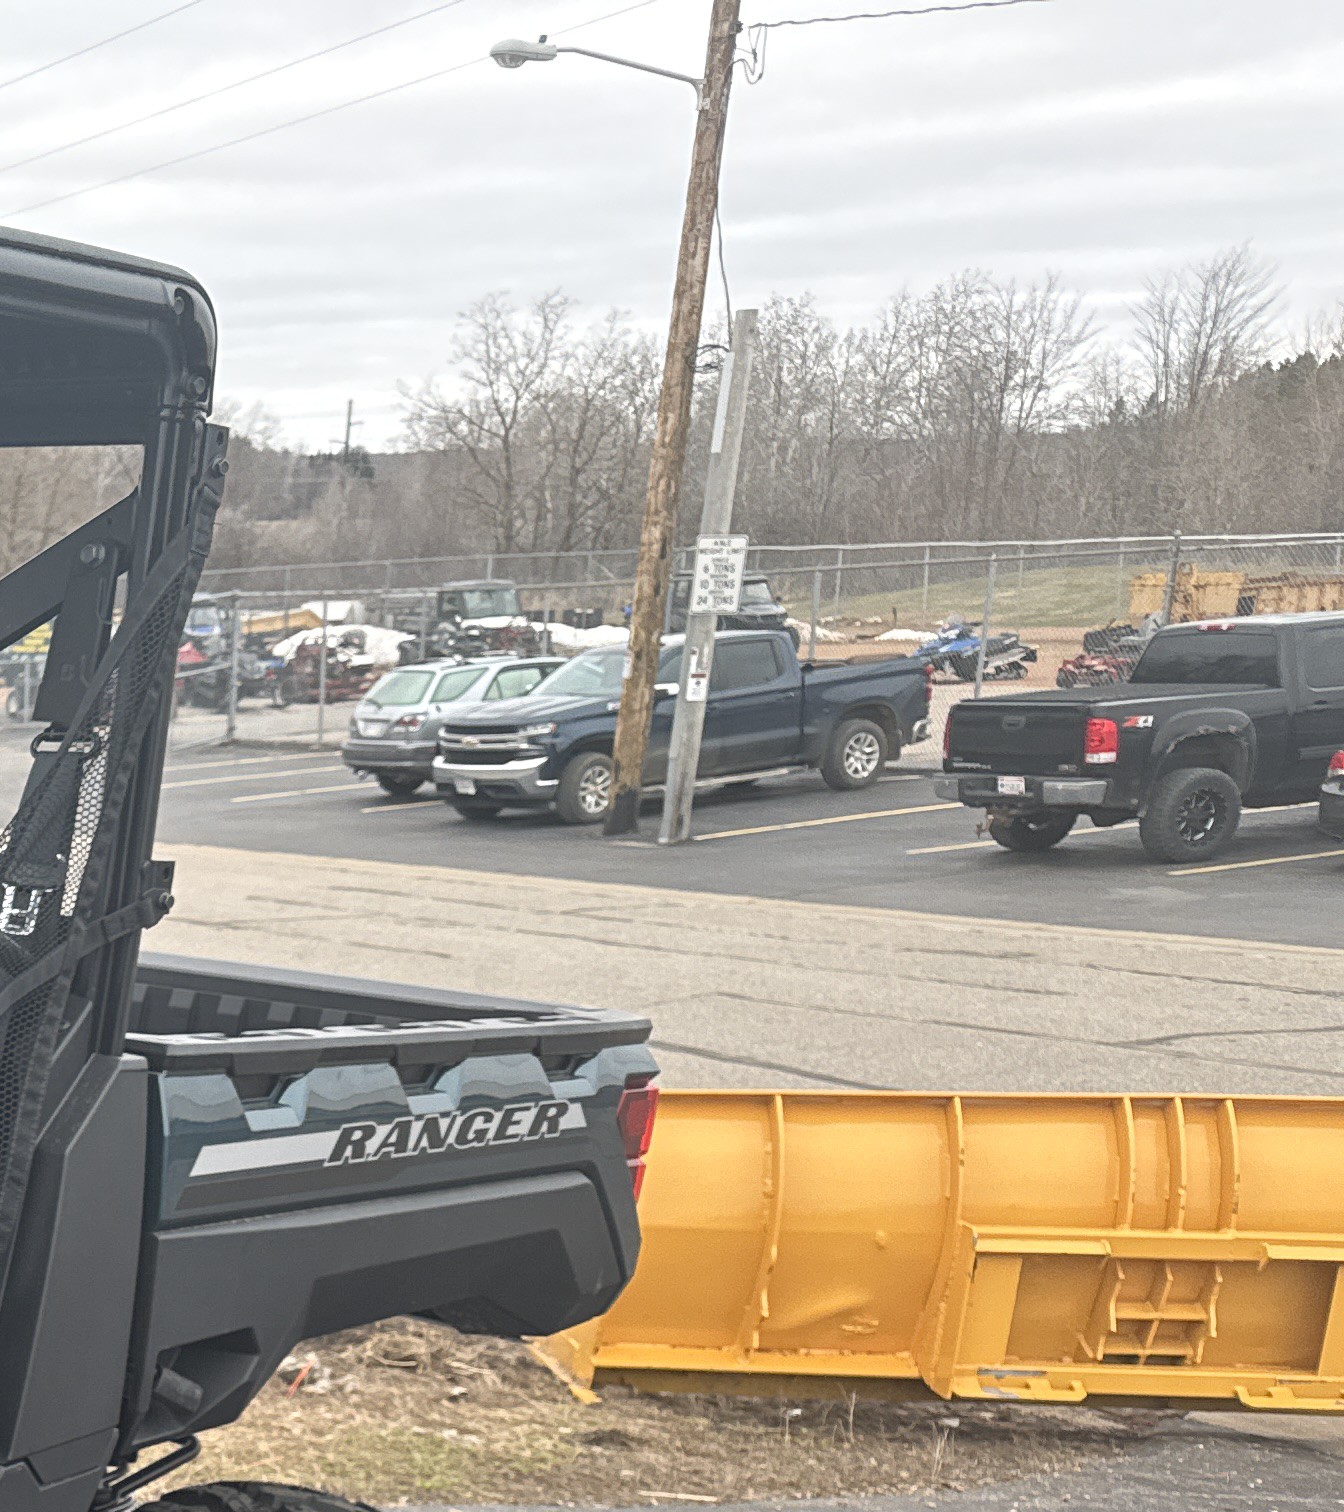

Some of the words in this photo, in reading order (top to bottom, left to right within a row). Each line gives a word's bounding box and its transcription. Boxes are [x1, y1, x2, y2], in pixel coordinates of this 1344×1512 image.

[713, 562, 736, 574] TONS
[714, 579, 736, 590] TONS
[713, 595, 735, 607] TONS
[322, 1098, 571, 1168] RANGER
